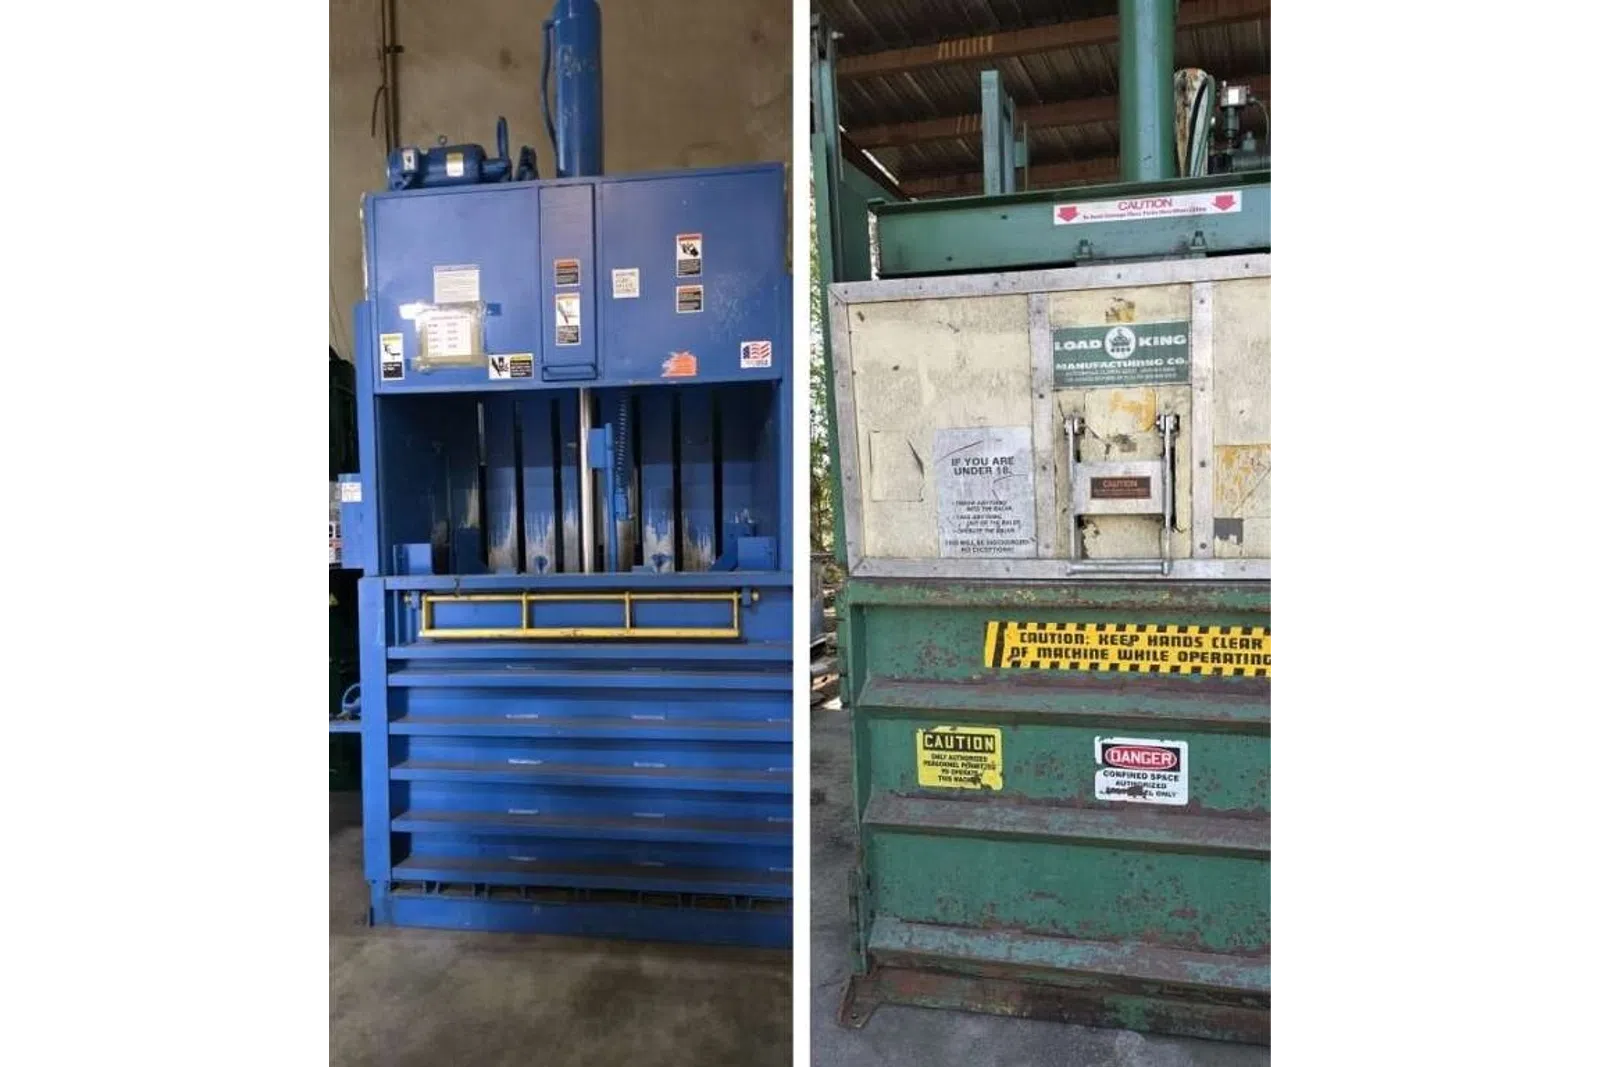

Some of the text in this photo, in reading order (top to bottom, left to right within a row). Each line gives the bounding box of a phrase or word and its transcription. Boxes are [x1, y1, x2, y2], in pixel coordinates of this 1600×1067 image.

[1118, 198, 1173, 211] CAUTION
[1054, 334, 1187, 351] LOAD KING
[1055, 358, 1164, 370] MANUFACTURING
[951, 456, 1014, 467] IF YOU ARE
[954, 466, 992, 476] UNDER
[1102, 479, 1138, 488] CAUTION
[1020, 631, 1263, 650] CAUTION: KEEP HANDS CLEAR
[1010, 646, 1028, 659] OF
[1037, 646, 1109, 660] MACHINE
[1117, 648, 1170, 663] WHILE
[924, 733, 995, 752] CAUTION
[923, 759, 960, 768] PERSONNEL
[949, 754, 988, 763] AUTHORIZED
[1110, 749, 1173, 767] DANGER
[938, 775, 952, 783] THIS
[1103, 769, 1180, 783] CONFINED SPACE
[1115, 780, 1167, 789] AUTHORIZED
